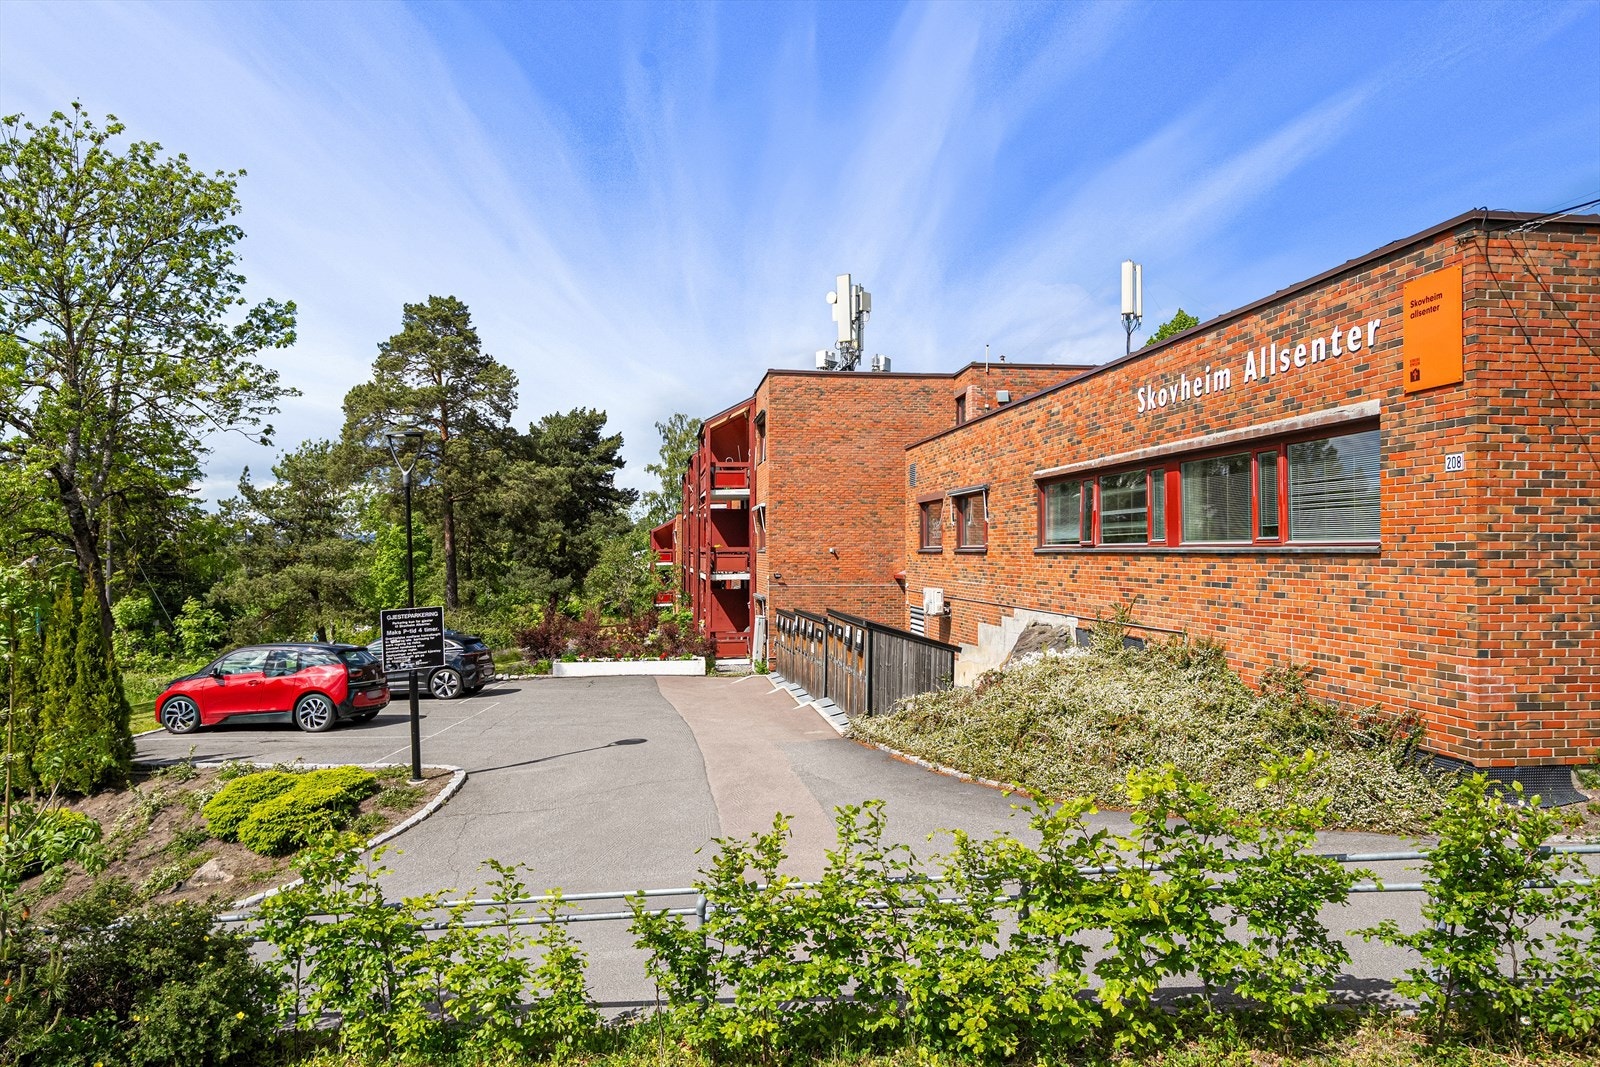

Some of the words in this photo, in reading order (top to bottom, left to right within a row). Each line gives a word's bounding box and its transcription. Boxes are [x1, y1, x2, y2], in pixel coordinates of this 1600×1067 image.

[1410, 292, 1443, 309] Skovheim
[1410, 304, 1441, 319] allsenter
[1137, 366, 1231, 413] Skovheim
[1243, 318, 1381, 384] Allsenter
[1446, 455, 1462, 470] 208
[386, 611, 439, 620] GJESTEPARKERING
